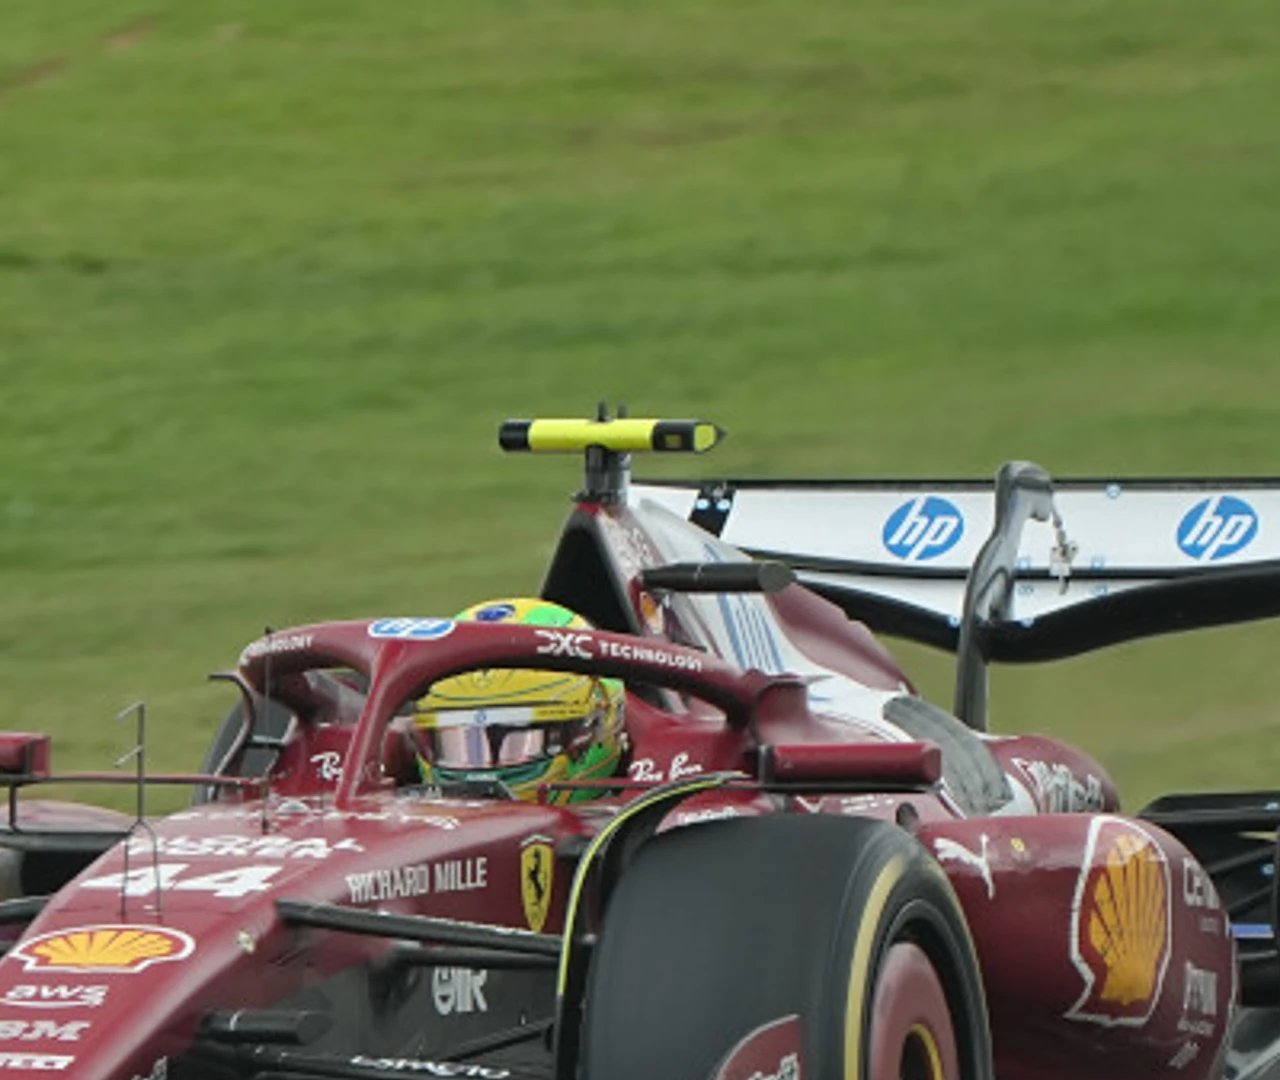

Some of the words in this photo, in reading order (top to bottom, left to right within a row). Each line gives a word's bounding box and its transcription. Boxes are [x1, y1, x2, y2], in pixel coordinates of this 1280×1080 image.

[886, 496, 961, 560] hp
[1180, 496, 1256, 560] hp
[598, 639, 703, 672] TECHNOLOGY
[78, 863, 284, 898] 44
[346, 863, 429, 903] RICHARD
[435, 857, 488, 892] MILLE
